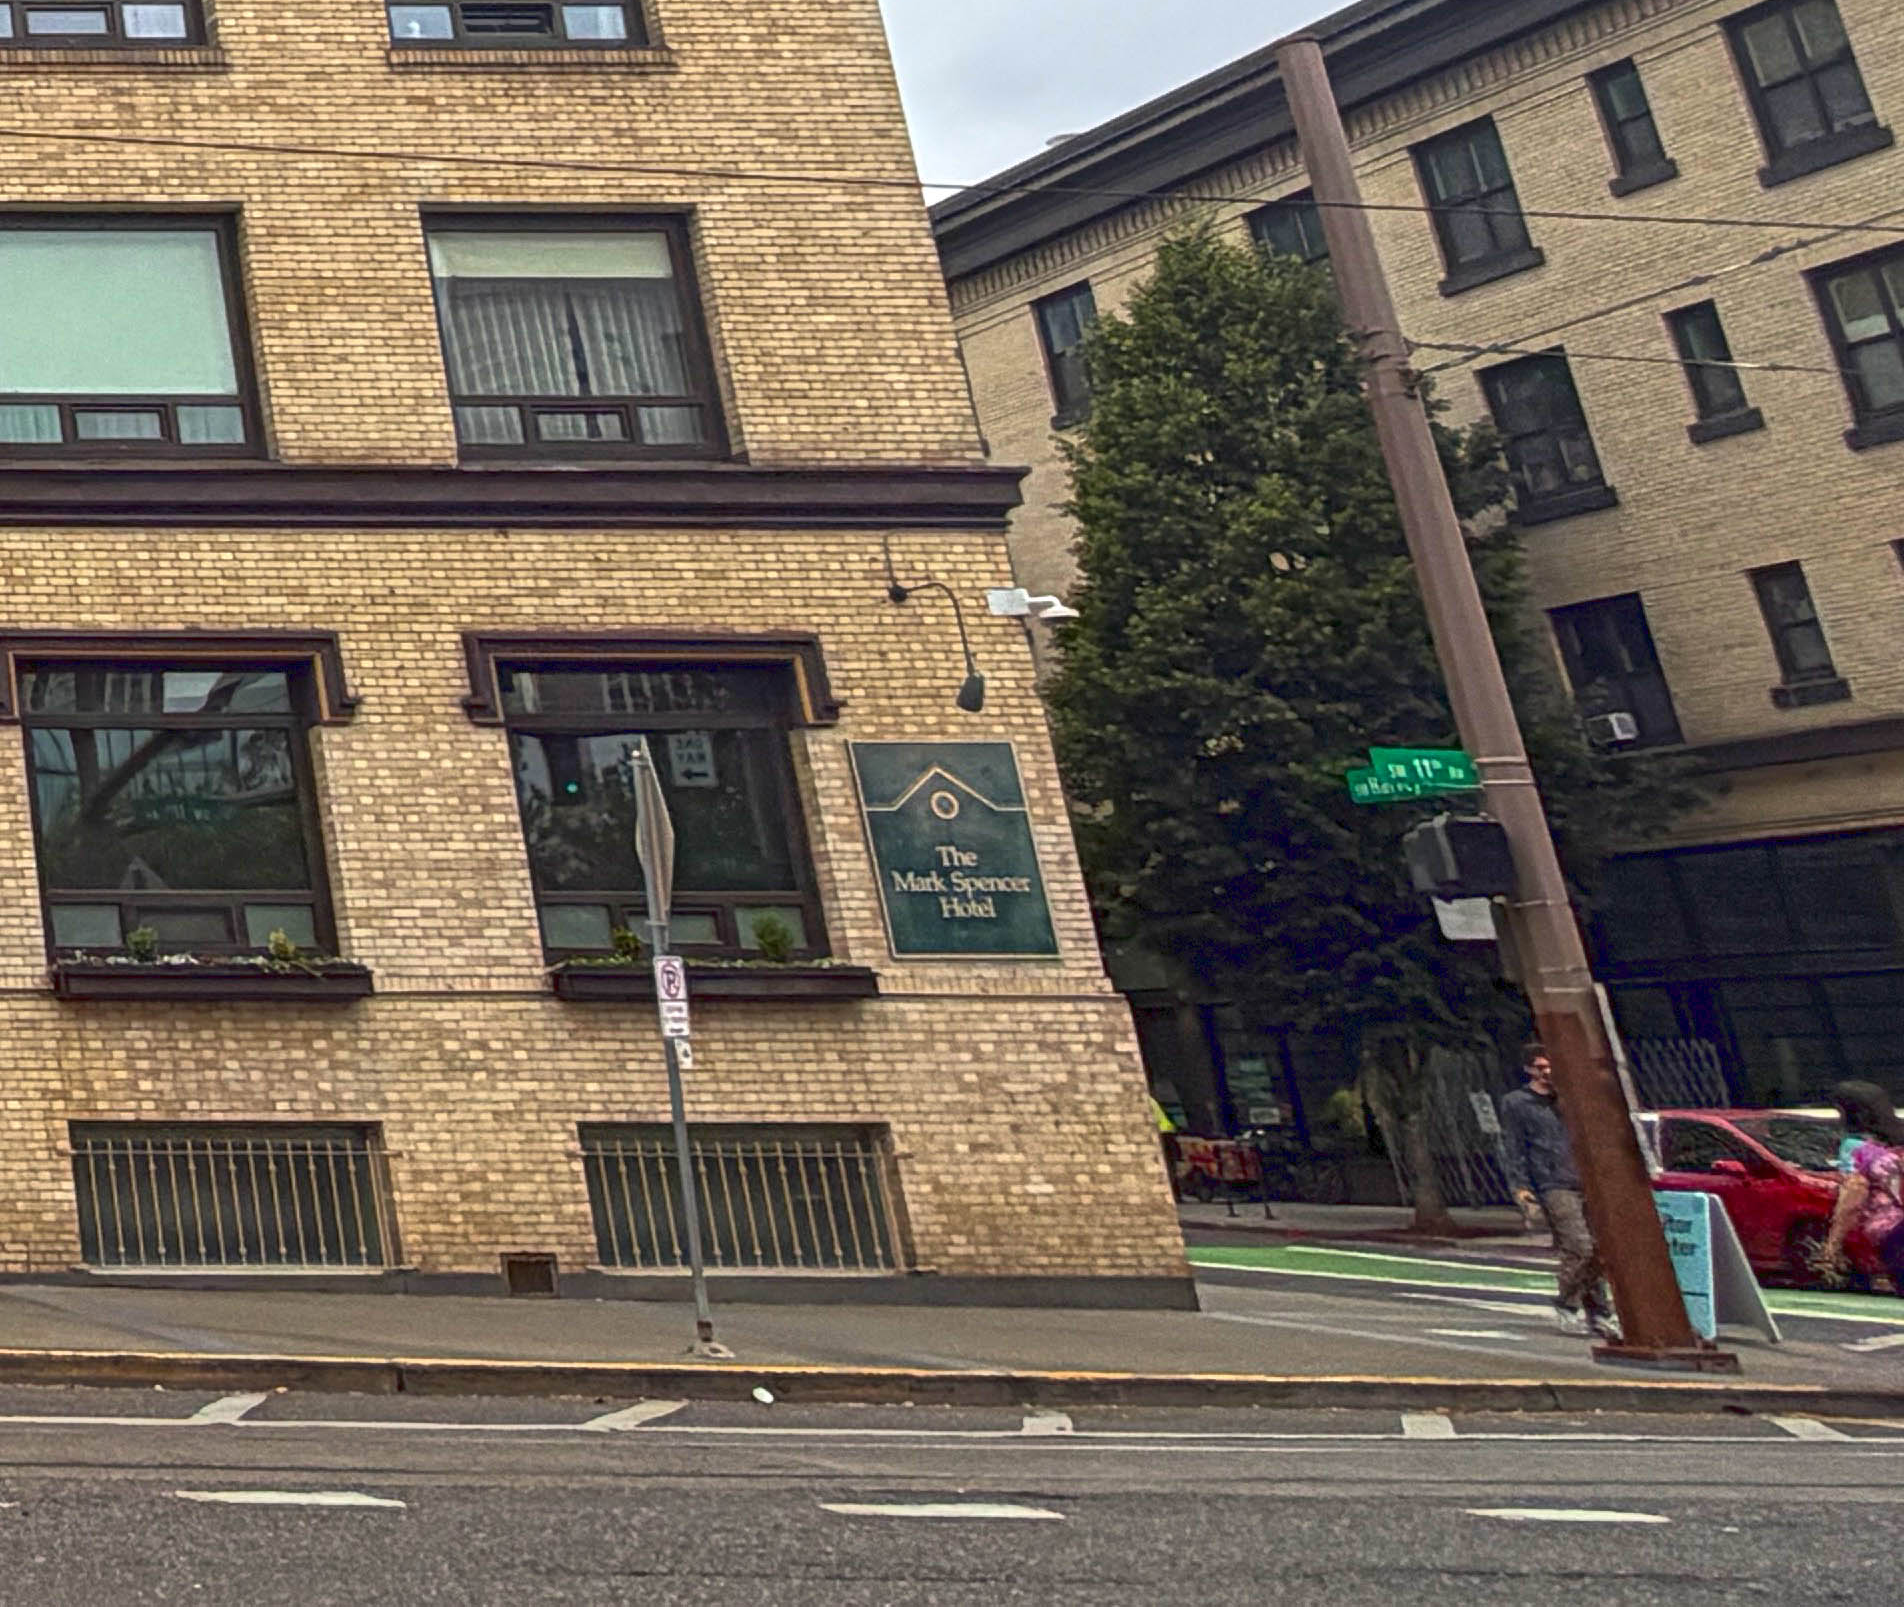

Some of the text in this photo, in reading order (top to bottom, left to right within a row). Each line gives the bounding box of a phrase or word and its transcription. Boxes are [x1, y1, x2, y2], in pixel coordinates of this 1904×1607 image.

[935, 846, 978, 867] The
[891, 871, 1032, 899] Mark Spencer
[940, 896, 997, 918] Hotel
